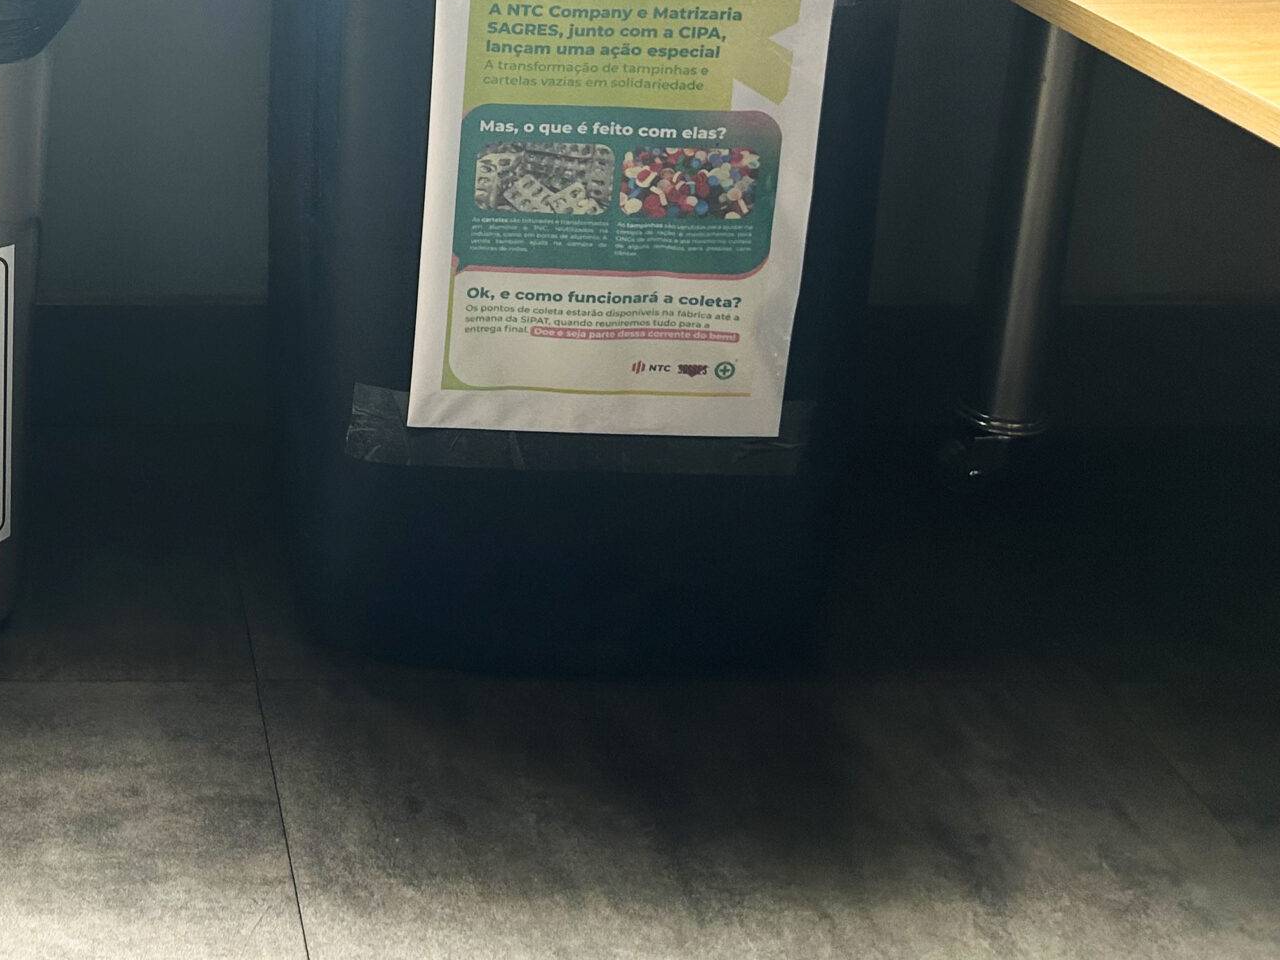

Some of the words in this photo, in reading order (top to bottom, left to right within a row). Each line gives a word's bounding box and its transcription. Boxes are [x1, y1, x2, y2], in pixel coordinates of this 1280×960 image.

[488, 3, 501, 15] A
[507, 3, 544, 17] NTC
[548, 5, 633, 20] Company
[637, 8, 648, 18] e
[653, 6, 743, 21] Matrizaria
[487, 21, 563, 38] SAGRES,
[566, 23, 615, 39] junto
[620, 27, 658, 38] com
[663, 28, 674, 38] a
[679, 26, 726, 42] CIPA,
[486, 39, 551, 57] lançam
[556, 45, 595, 55] uma
[600, 43, 642, 59] ação
[647, 44, 721, 60] especial
[484, 60, 494, 70] A
[498, 61, 599, 75] transformação
[602, 63, 619, 73] de
[623, 64, 697, 76] tampinhas
[701, 67, 709, 75] e
[482, 76, 536, 86] cartelas
[540, 77, 580, 87] vazias
[585, 79, 608, 87] em
[610, 78, 704, 90] solidariedade
[479, 120, 519, 135] Mas,
[523, 123, 534, 133] o
[539, 122, 573, 136] que
[577, 120, 588, 134] é
[592, 122, 633, 136] feito
[638, 126, 677, 138] com
[681, 126, 727, 140] elas?
[466, 287, 495, 301] Ok,
[500, 290, 510, 299] e
[515, 291, 563, 302] como
[568, 291, 659, 304] funcionará
[663, 294, 673, 304] a
[678, 295, 742, 308] coleta?
[465, 304, 478, 312] Os
[481, 305, 515, 314] pontos
[517, 305, 530, 313] de
[532, 307, 563, 315] coleta
[566, 308, 603, 317] estarão
[605, 308, 659, 318] disponíveis
[662, 309, 674, 317] na
[677, 309, 712, 319] fábrica
[714, 312, 731, 321] até
[465, 315, 503, 323] semana
[505, 314, 517, 323] da
[553, 318, 593, 327] quando
[595, 319, 651, 327] reuniremos
[653, 319, 677, 327] tudo
[678, 321, 701, 329] para
[464, 325, 501, 334] entrega
[566, 328, 587, 338] seja
[588, 330, 616, 339] parte
[617, 330, 646, 338] dessa
[648, 330, 691, 339] corrente
[693, 331, 707, 339] do
[649, 364, 671, 372] NTC
